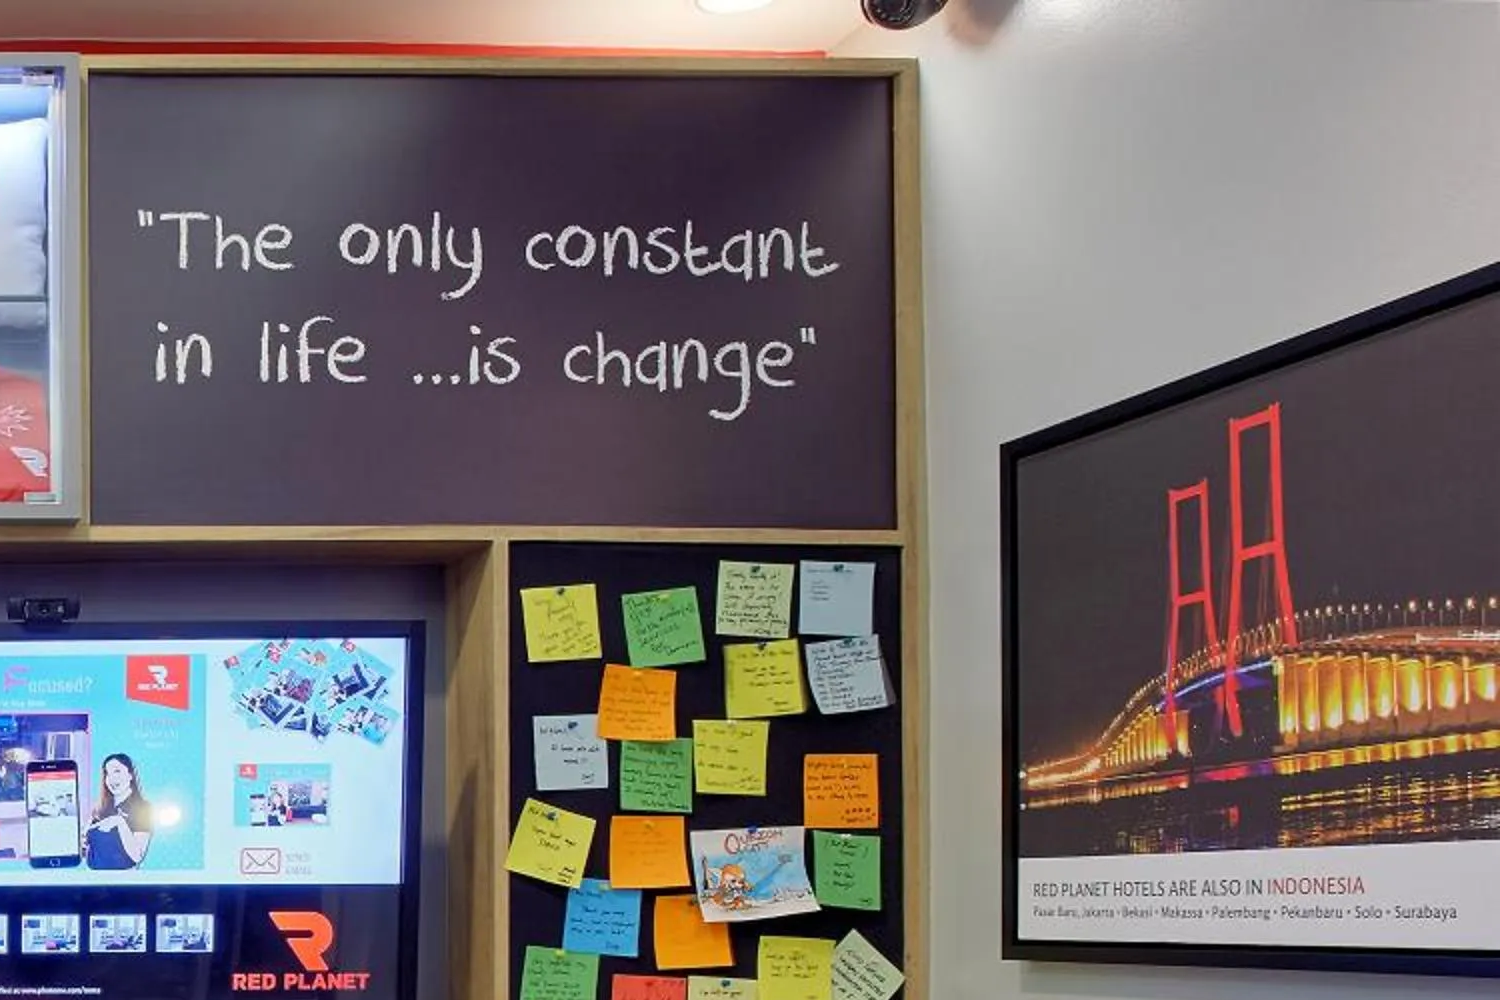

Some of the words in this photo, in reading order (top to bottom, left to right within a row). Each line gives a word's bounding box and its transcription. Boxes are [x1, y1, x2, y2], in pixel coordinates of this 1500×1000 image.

[137, 210, 294, 271] "The
[339, 211, 483, 301] only
[525, 219, 840, 281] constant
[154, 321, 213, 384] in
[258, 315, 368, 384] life
[412, 326, 521, 386] ...is
[563, 328, 816, 422] change"
[1033, 882, 1058, 897] RED
[1061, 881, 1110, 897] PLANET
[1113, 881, 1165, 897] HOTELS
[1169, 880, 1197, 897] ARE
[1201, 879, 1240, 897] ALSO
[1245, 879, 1263, 895] IN
[1267, 876, 1365, 895] INDONESIA
[1211, 905, 1270, 920] Palembang
[1281, 905, 1343, 919] Pekanbaru
[1354, 905, 1383, 919] Solo
[1394, 905, 1458, 922] Surabaya
[232, 973, 275, 991] RED
[284, 973, 370, 991] PLANET
